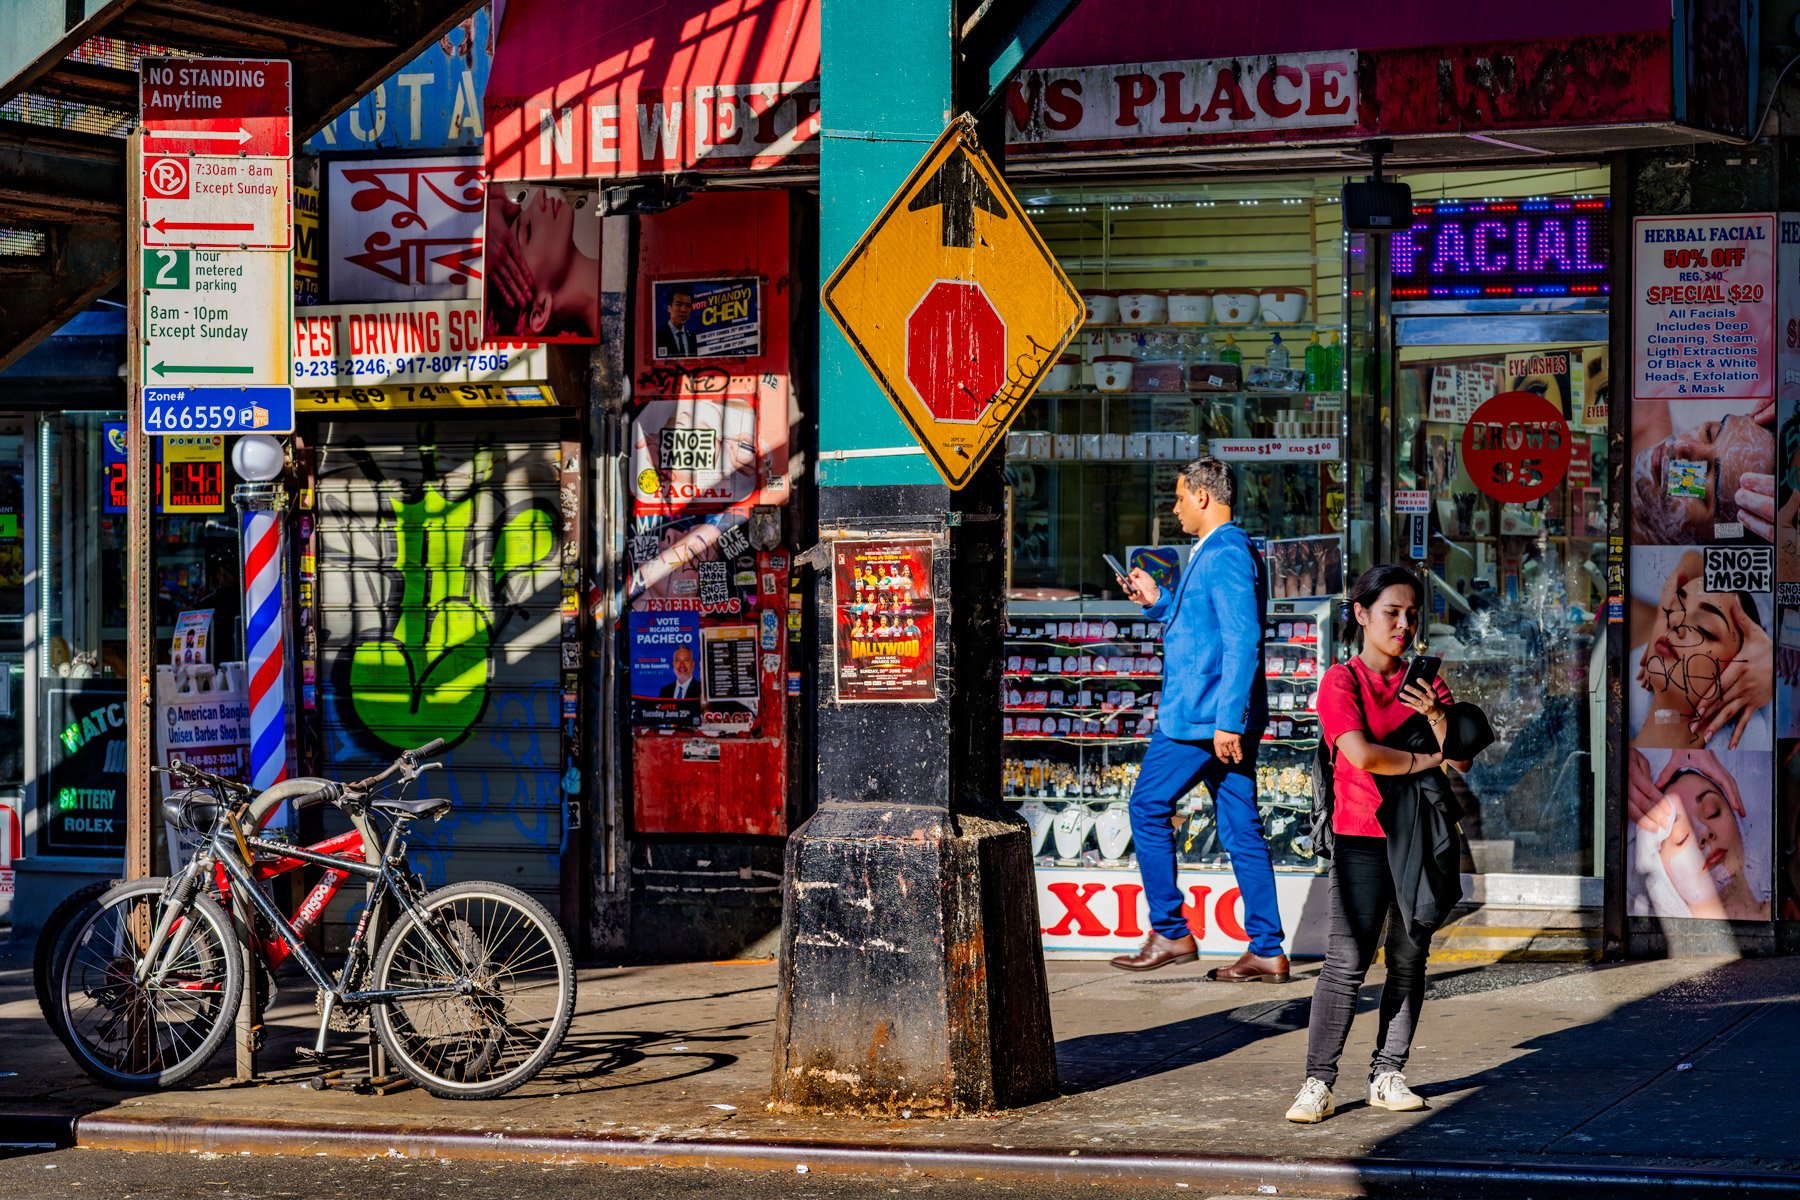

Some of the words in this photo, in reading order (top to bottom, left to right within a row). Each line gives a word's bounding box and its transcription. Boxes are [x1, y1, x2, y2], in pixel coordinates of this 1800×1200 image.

[150, 68, 174, 85] NO
[180, 69, 265, 88] STANDING
[151, 90, 222, 112] Anytime
[1114, 61, 1351, 127] PLACE
[540, 101, 683, 165] NEW
[196, 164, 237, 176] 7:30am
[248, 164, 273, 176] 8am
[196, 182, 234, 196] Except
[238, 183, 278, 197] Sunday
[1644, 228, 1706, 243] HERBAL
[1710, 226, 1765, 242] FACIAL
[1398, 219, 1605, 274] FACIAL
[1664, 248, 1708, 268] 50%
[1711, 248, 1746, 267] OFF
[156, 250, 178, 285] 2
[196, 251, 220, 262] hour
[196, 265, 242, 276] metered
[1679, 272, 1702, 282] REG.
[1705, 271, 1723, 282] $40
[196, 279, 237, 293] parking
[1647, 285, 1726, 304] SPECIAL
[1728, 284, 1764, 305] $20
[150, 306, 180, 320] 8am
[194, 306, 228, 322] 10pm
[692, 300, 707, 310] VOTE
[702, 300, 748, 326] CHEN
[1668, 310, 1686, 318] All
[1690, 309, 1736, 318] Facials
[150, 324, 196, 340] Except
[200, 324, 248, 342] Sunday
[294, 315, 342, 358] FEST
[350, 311, 440, 356] DRIVING
[1656, 322, 1711, 331] Includes
[1716, 322, 1748, 332] Deep
[1648, 334, 1708, 345] Cleaning,
[1712, 334, 1757, 344] Steam,
[1647, 347, 1680, 358] Ligth
[1684, 346, 1758, 356] Extractions
[396, 354, 509, 374] 917-807-7505
[1509, 358, 1525, 377] EYE
[1528, 354, 1567, 374] LASHES
[1648, 359, 1662, 368] Of
[1666, 359, 1702, 368] Black
[1706, 360, 1716, 368] &
[1719, 358, 1757, 368] White
[1645, 372, 1689, 382] Heads,
[1693, 371, 1760, 381] Exfolation
[148, 391, 185, 401] Zone#
[309, 388, 385, 404] 37-69
[399, 385, 450, 402] 74th
[459, 384, 502, 401] ST.
[1678, 384, 1688, 394] &
[1692, 384, 1726, 393] Mask
[148, 406, 236, 428] 466559
[1472, 421, 1562, 450] BROWS
[1491, 459, 1544, 486] $5
[173, 495, 219, 505] MILLION
[653, 484, 732, 498] FACIAL
[718, 525, 743, 548] OYE
[723, 536, 750, 560] RUNS
[637, 634, 692, 644] PACHECO
[852, 640, 920, 658] DALLYWOOD
[178, 706, 218, 722] American
[642, 710, 664, 719] Tuesday
[665, 710, 678, 718] June
[168, 727, 194, 744] Unisex
[195, 725, 218, 741] Barber
[220, 724, 238, 742] Shop
[60, 788, 114, 810] BATTERY
[64, 817, 114, 834] ROLEX
[292, 870, 338, 934] mongoose
